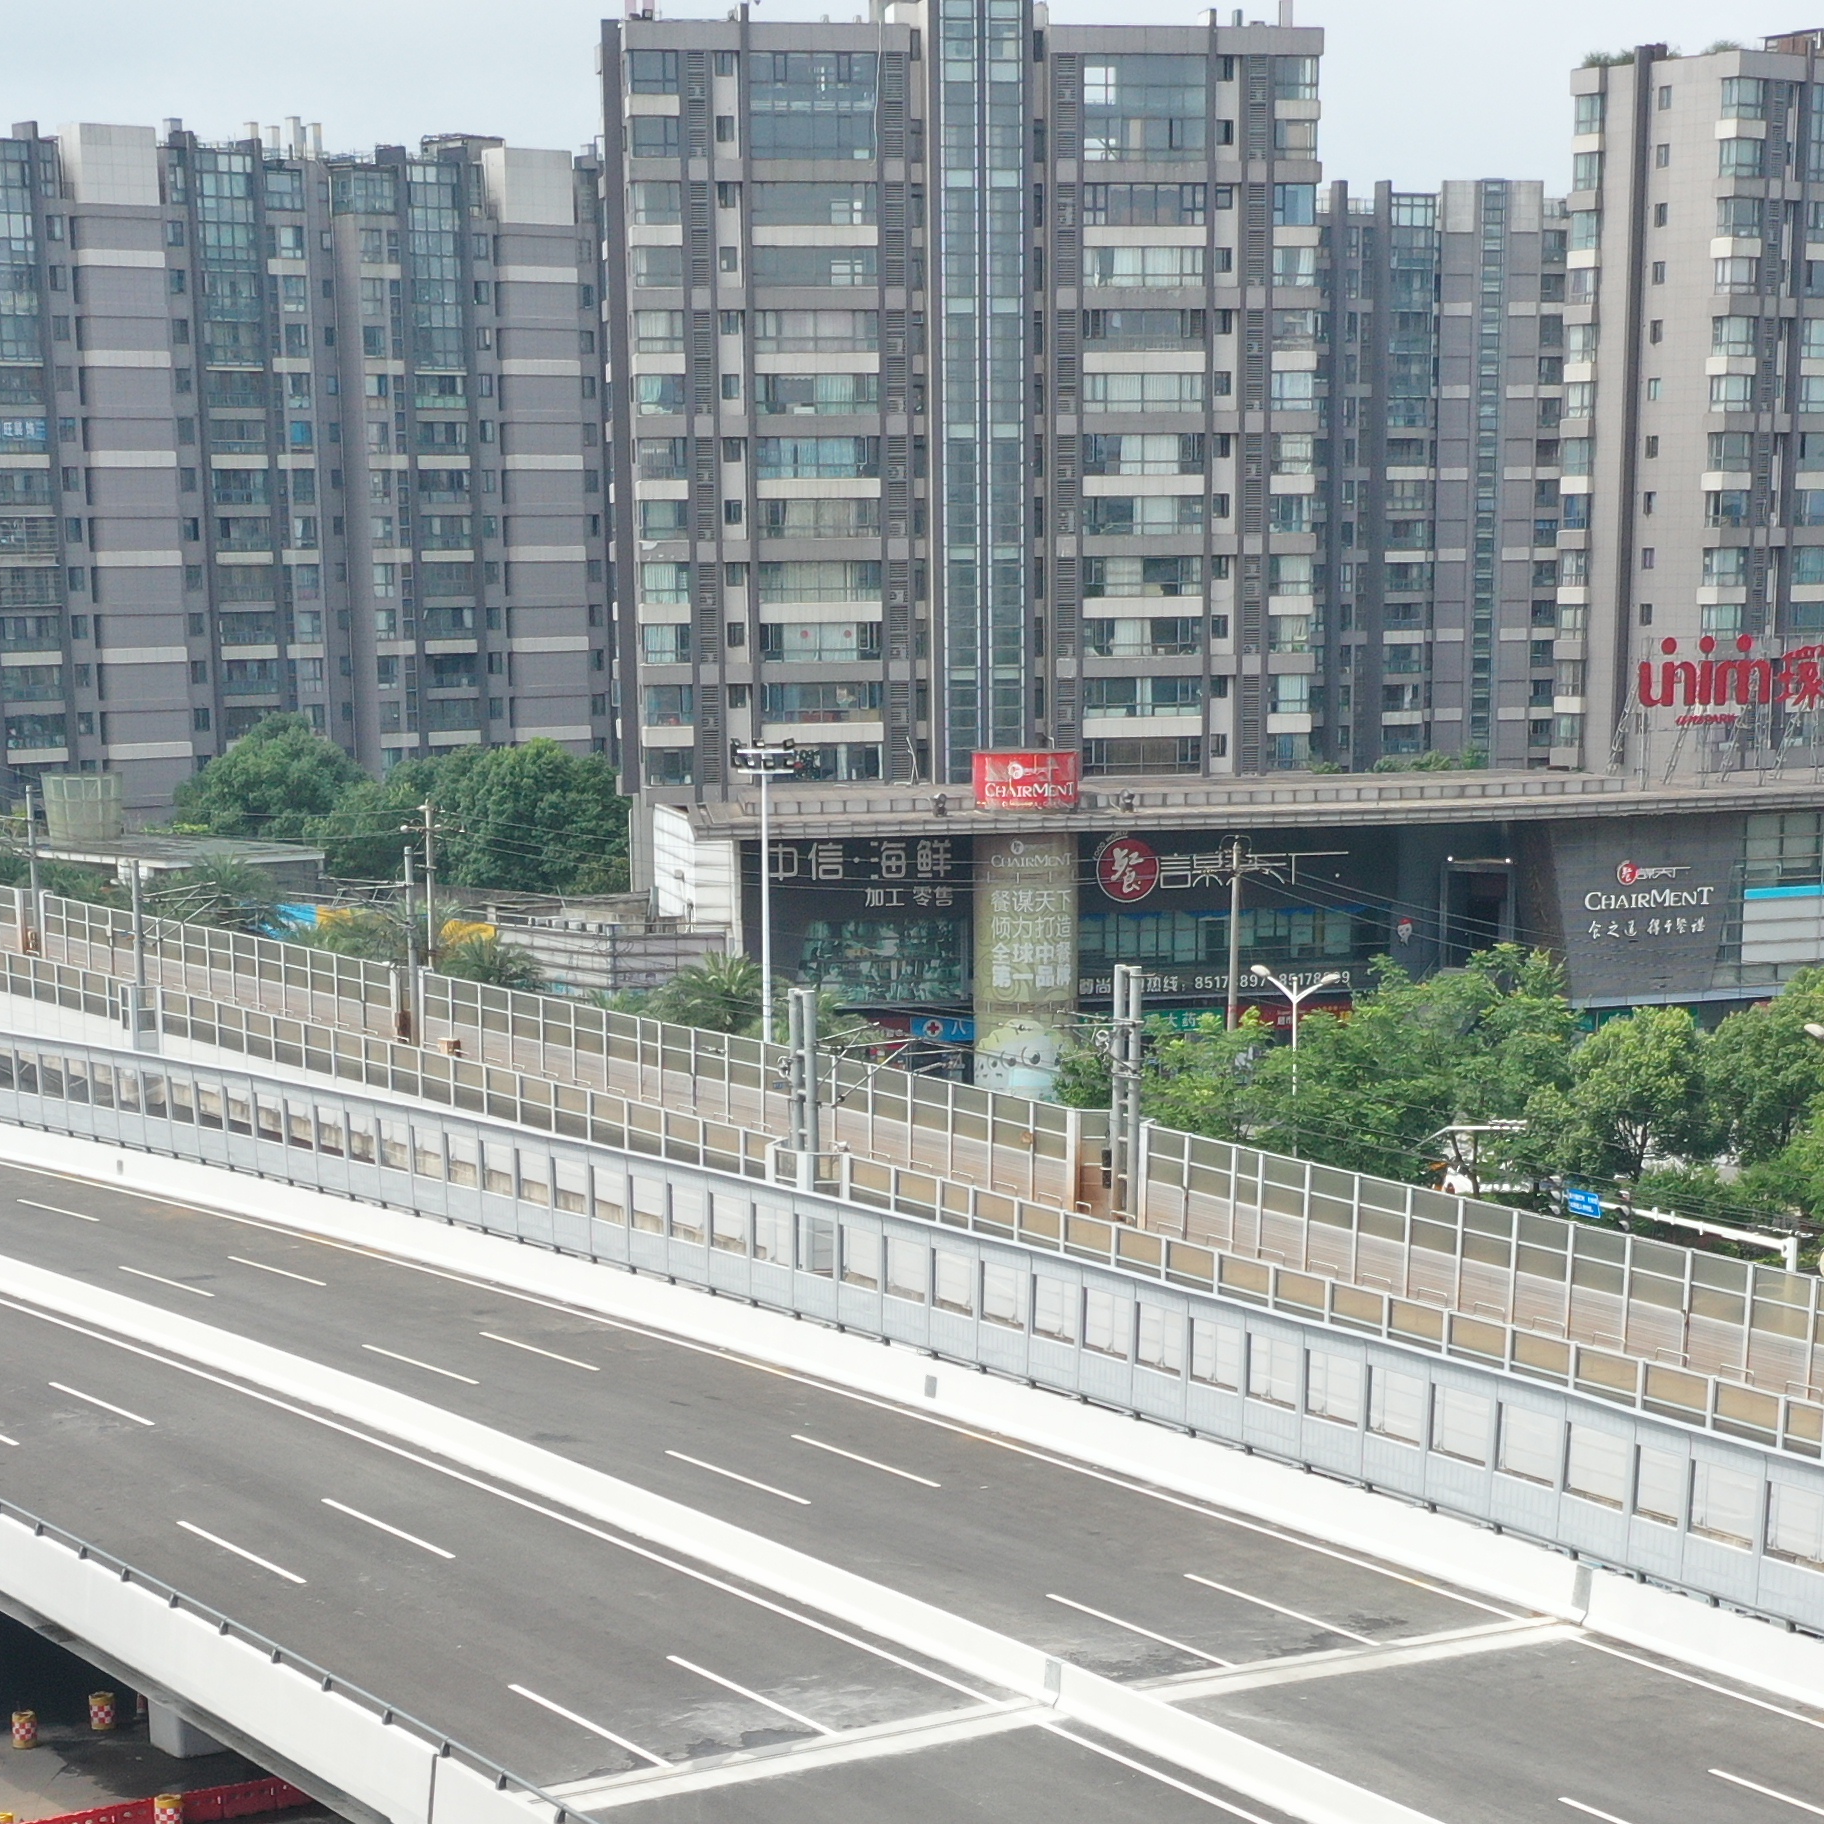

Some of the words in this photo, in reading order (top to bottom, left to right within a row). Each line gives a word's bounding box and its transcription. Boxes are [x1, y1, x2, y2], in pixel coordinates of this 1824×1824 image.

[865, 887, 905, 907] 加工
[913, 886, 952, 907] 零售
[991, 890, 1072, 912] 餐谋天下
[991, 916, 1072, 939] 倾力打造
[991, 942, 1072, 965] 全球中餐
[991, 964, 1072, 988] 第一品牌
